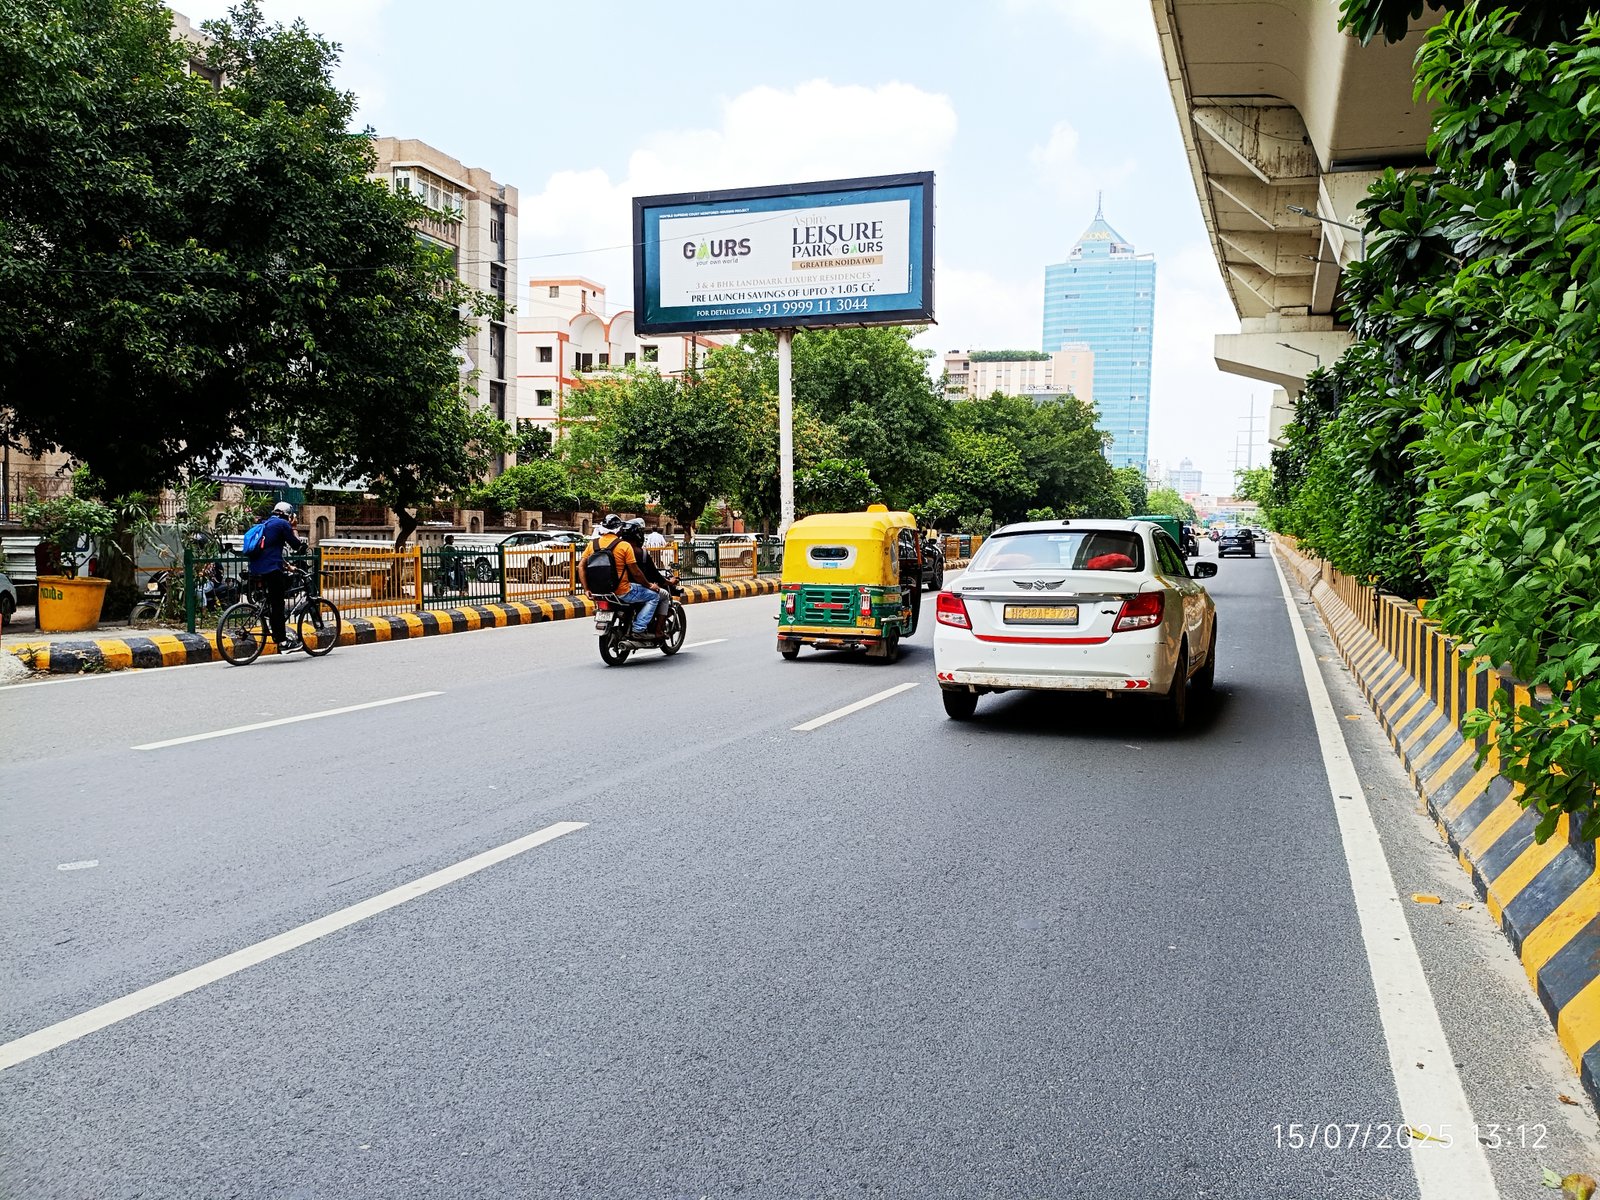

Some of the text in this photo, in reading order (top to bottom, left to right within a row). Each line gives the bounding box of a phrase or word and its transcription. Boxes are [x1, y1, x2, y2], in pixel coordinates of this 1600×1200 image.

[792, 220, 884, 245] LEISURE
[683, 238, 751, 259] GAURS
[792, 244, 832, 258] PARK
[842, 241, 883, 254] GAURS
[800, 259, 835, 268] GREATER
[835, 258, 861, 266] NOIDA
[736, 278, 782, 287] LANDMARK
[786, 276, 817, 284] LUXURY
[820, 272, 870, 281] RESIDENCES
[692, 294, 706, 302] PRE
[709, 292, 745, 301] LAUNCH
[747, 290, 785, 299] SAVINGS
[803, 287, 827, 296] UPTO
[839, 284, 858, 294] 1.05
[756, 303, 778, 315] +91
[782, 301, 813, 314] 9999
[818, 300, 831, 312] 11
[836, 298, 868, 311] 3044
